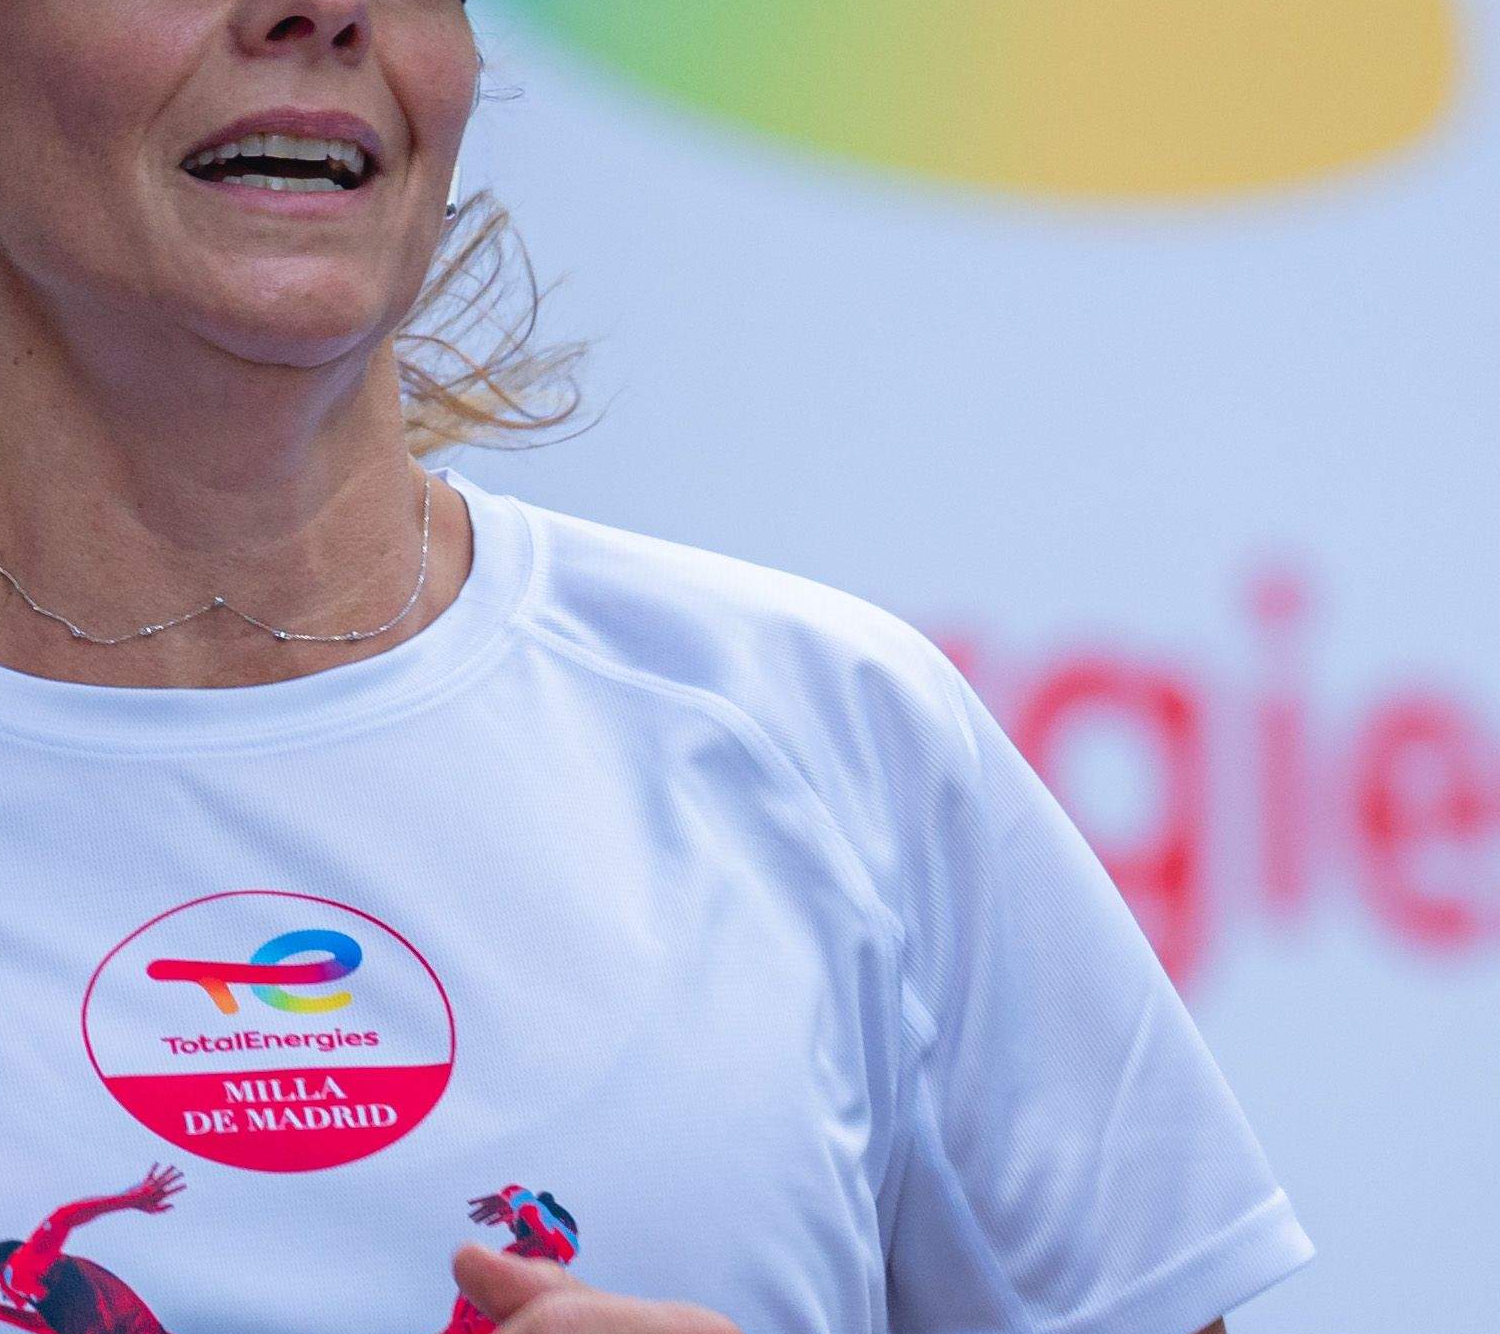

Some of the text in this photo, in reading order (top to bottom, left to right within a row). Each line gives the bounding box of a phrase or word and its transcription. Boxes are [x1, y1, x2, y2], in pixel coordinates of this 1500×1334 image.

[161, 1028, 380, 1056] TotalEnergies
[222, 1075, 348, 1104] MILLA
[183, 1103, 398, 1135] DE MADRID
